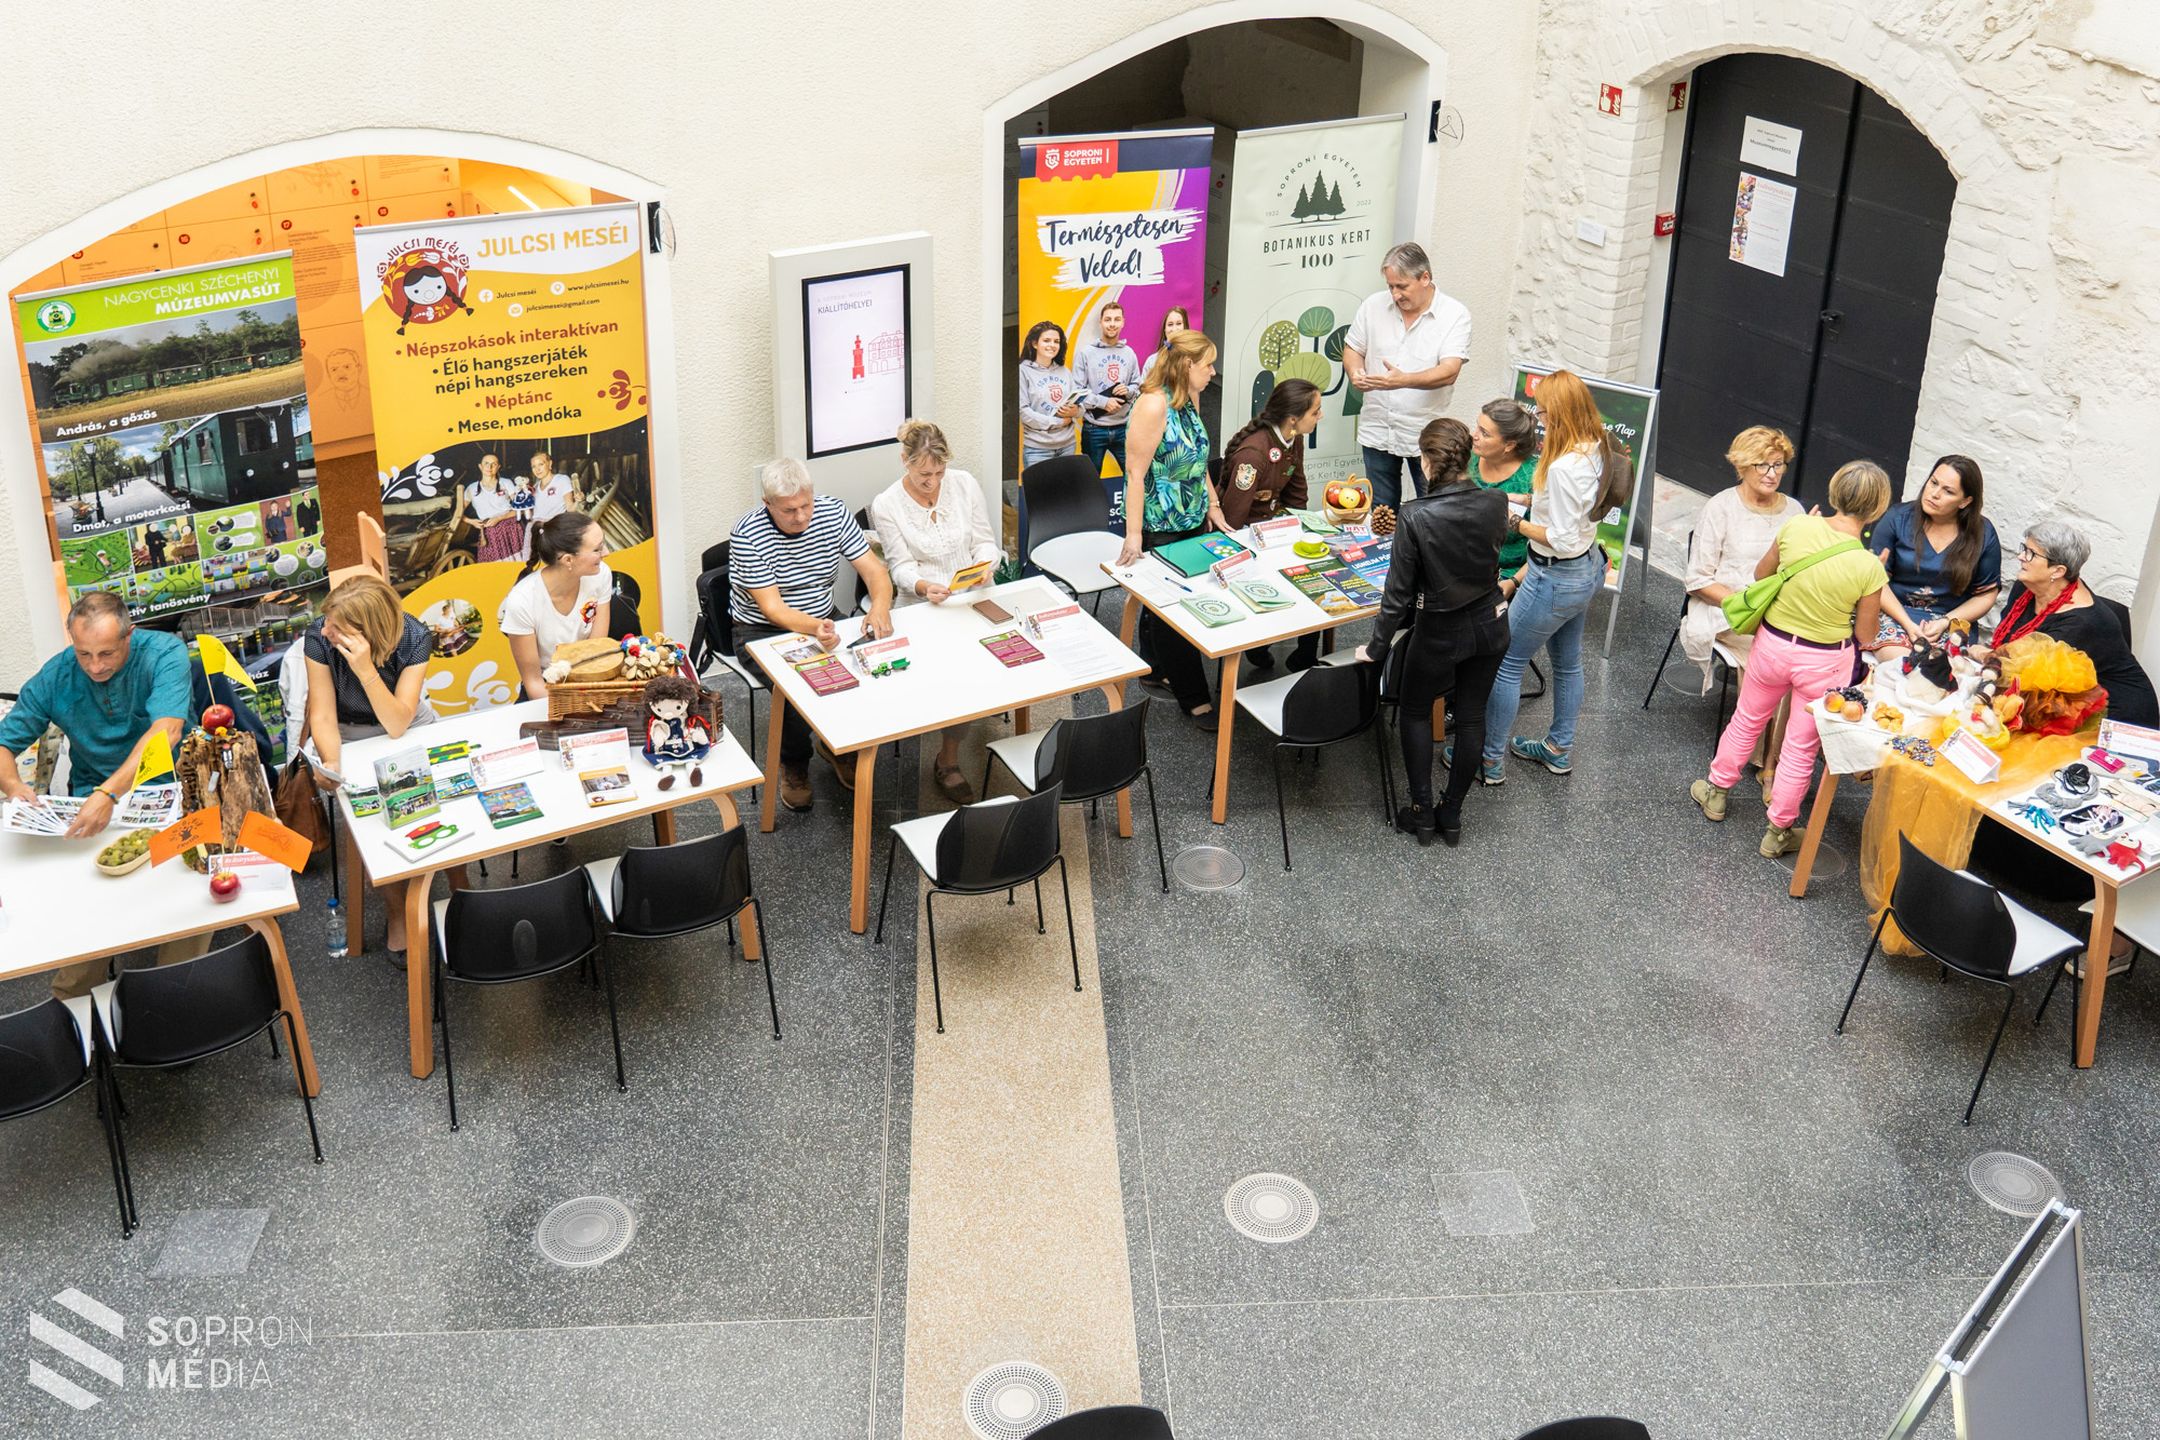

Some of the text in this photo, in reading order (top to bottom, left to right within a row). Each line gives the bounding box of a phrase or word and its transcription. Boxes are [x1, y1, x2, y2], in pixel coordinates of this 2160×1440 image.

[1064, 149, 1102, 158] SOPRONI
[1064, 157, 1102, 166] EGYETEM
[1277, 153, 1361, 198] SOPRONI EGYETEM
[477, 221, 628, 258] JULCSI MESÉI
[1046, 213, 1184, 252] Természetesen
[1264, 229, 1371, 253] BOTANIKUS KERT
[387, 238, 420, 260] JULCSI
[1301, 253, 1333, 268] 100
[1080, 249, 1141, 283] Veled!
[104, 282, 194, 309] NAGYCENKI
[200, 267, 279, 292] SZÉCHENYI
[155, 282, 281, 314] MÚZEUMVASÚT
[496, 291, 516, 299] Julcsi
[406, 321, 618, 358] Népszokások interaktívan
[443, 345, 588, 376] Élő hangszerjáték
[435, 363, 588, 397] népi hangszereken
[485, 391, 553, 410] Néptánc
[56, 409, 157, 437] András, a gőzös
[458, 407, 582, 434] Mese, mondóka
[1615, 424, 1636, 439] Nap
[73, 501, 191, 533] Dmot, a motorkocsi
[150, 594, 211, 612] tanösvény
